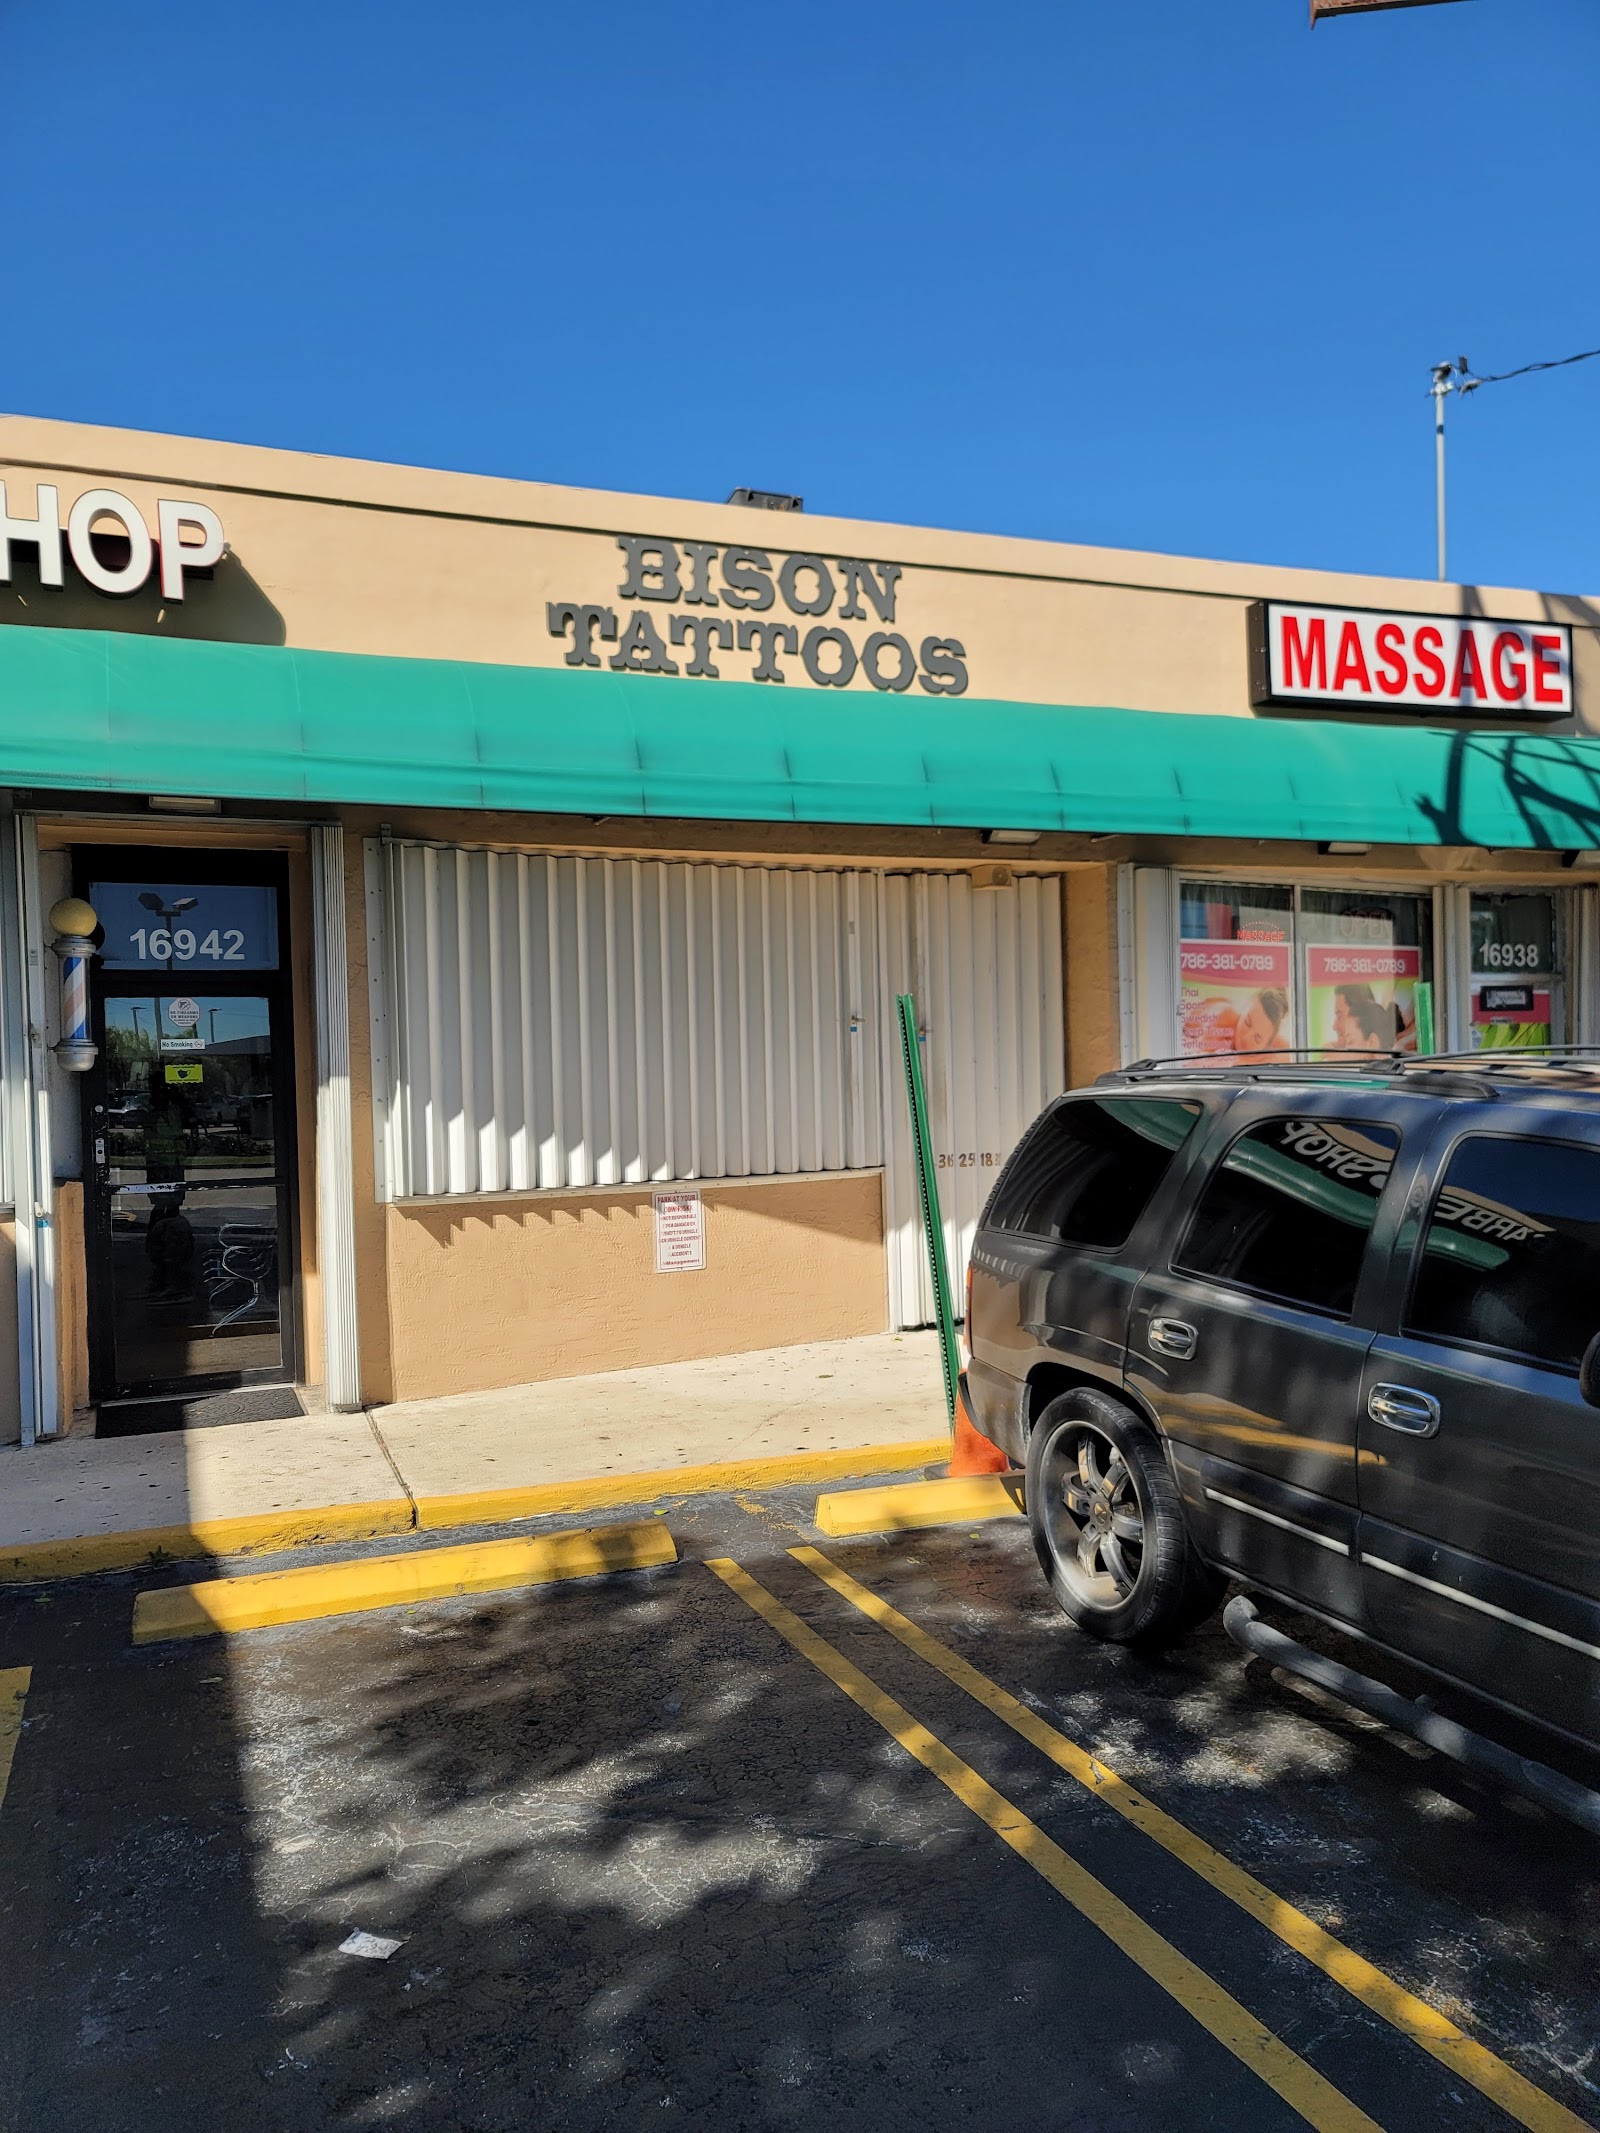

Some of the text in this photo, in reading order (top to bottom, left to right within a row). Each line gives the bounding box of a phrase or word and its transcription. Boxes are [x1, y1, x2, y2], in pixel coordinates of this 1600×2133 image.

[0, 479, 225, 601] HOP
[618, 536, 902, 624] BISON
[546, 601, 969, 695] TATTOOS
[1281, 615, 1563, 703] MASSAGE
[1340, 911, 1393, 938] OPEN
[129, 928, 246, 961] 16942
[1479, 938, 1539, 968] 16938
[1180, 952, 1274, 971] 786-381-0789
[1323, 957, 1406, 974] 786-381-0789
[657, 1194, 696, 1204] PARK AT YOUR
